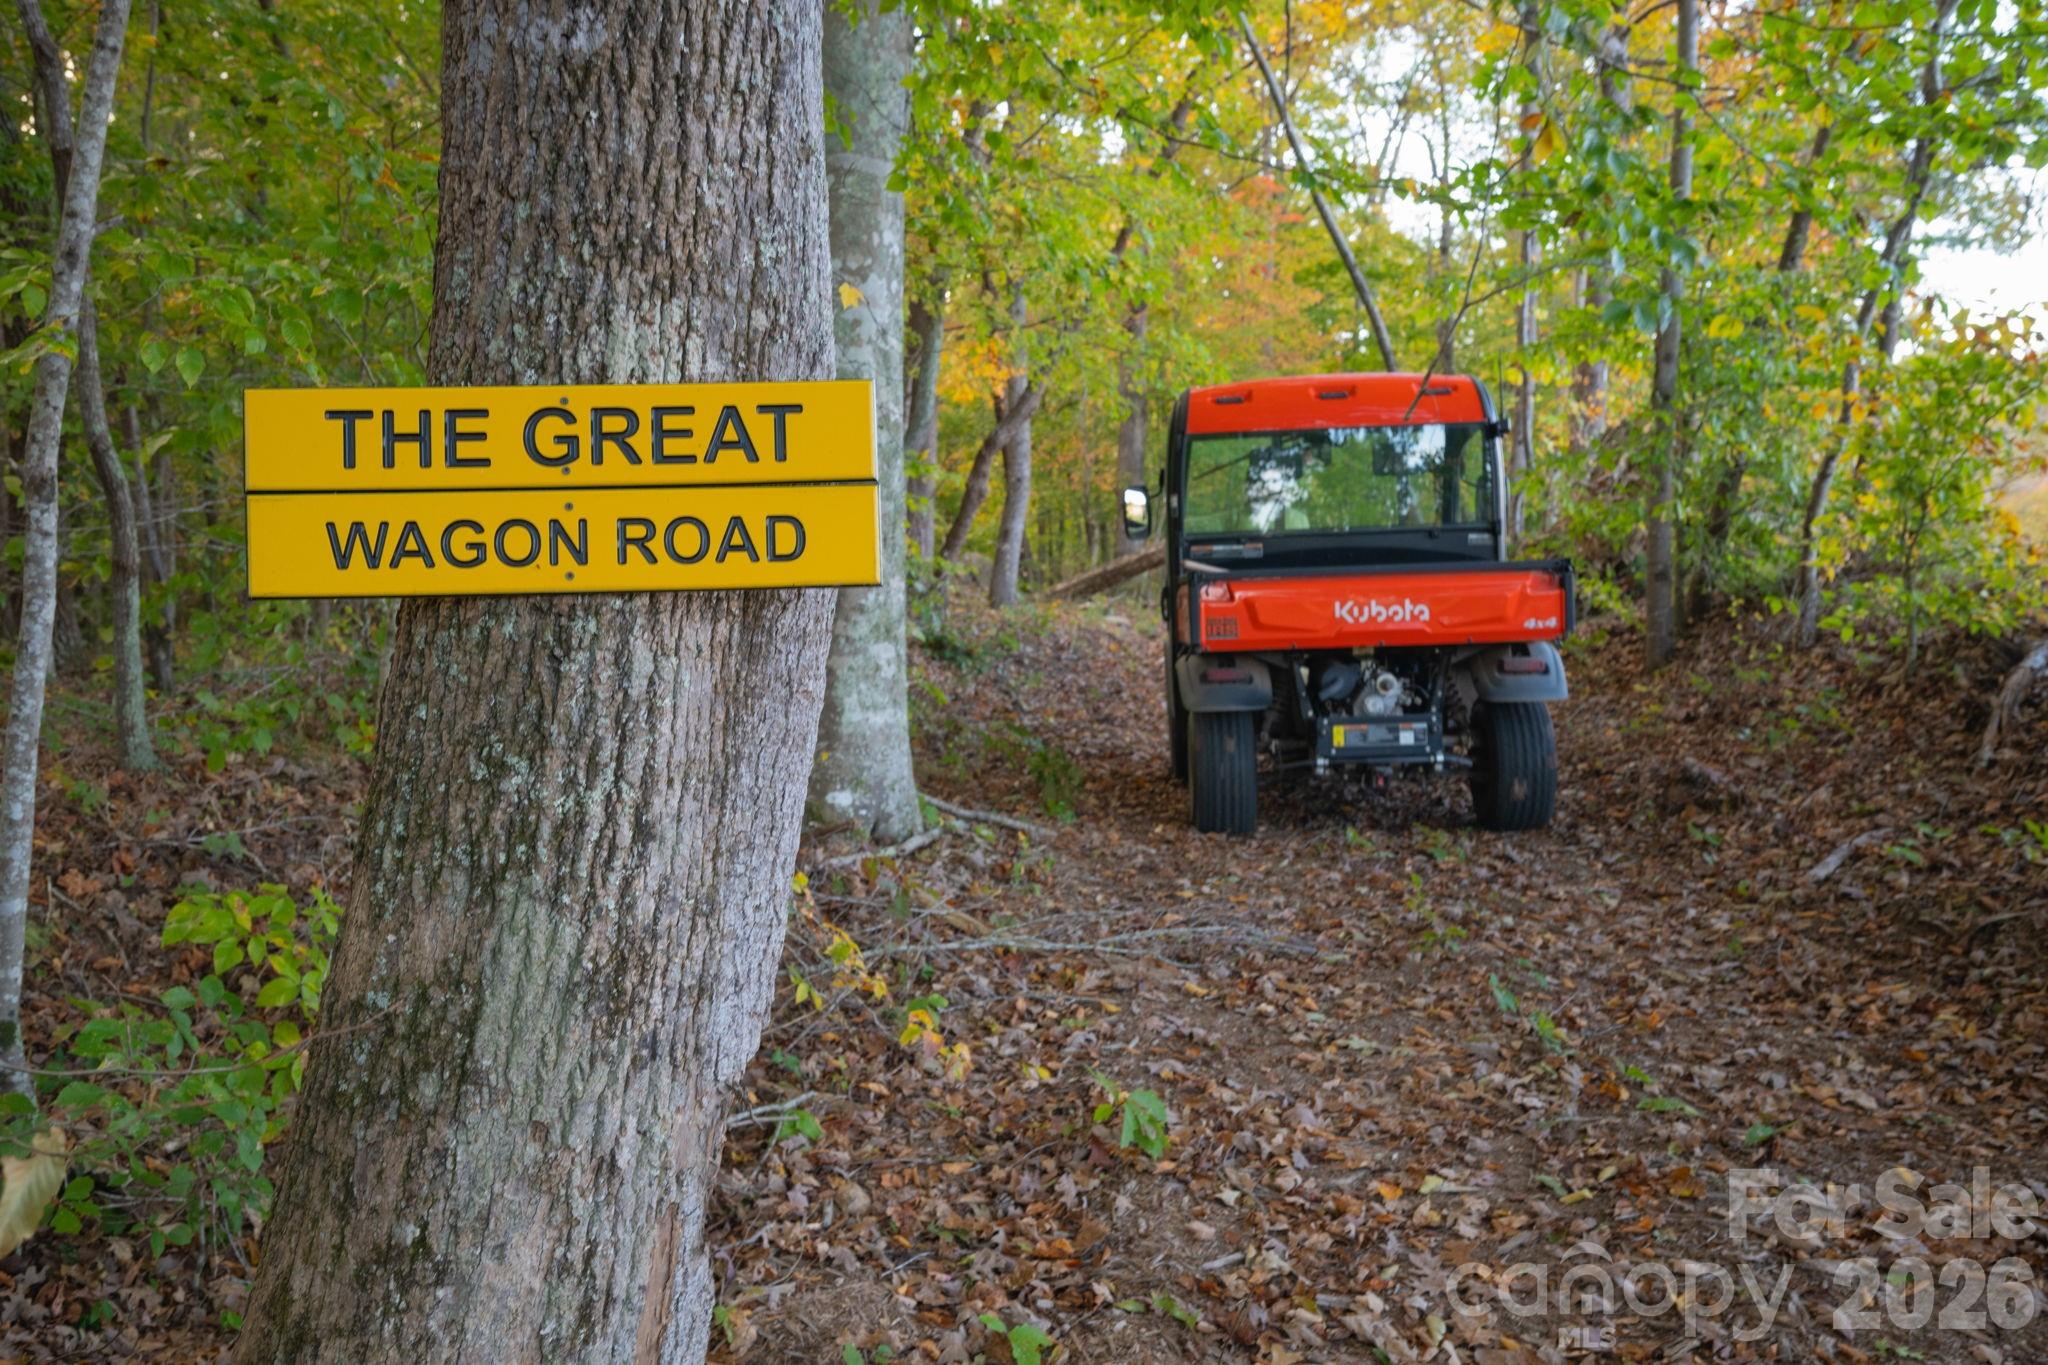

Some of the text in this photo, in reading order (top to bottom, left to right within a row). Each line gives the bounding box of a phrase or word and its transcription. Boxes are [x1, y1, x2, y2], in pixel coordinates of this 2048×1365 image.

[325, 405, 803, 468] THE GREAT
[326, 515, 806, 569] WAGON ROAD
[1334, 598, 1430, 624] Kubota
